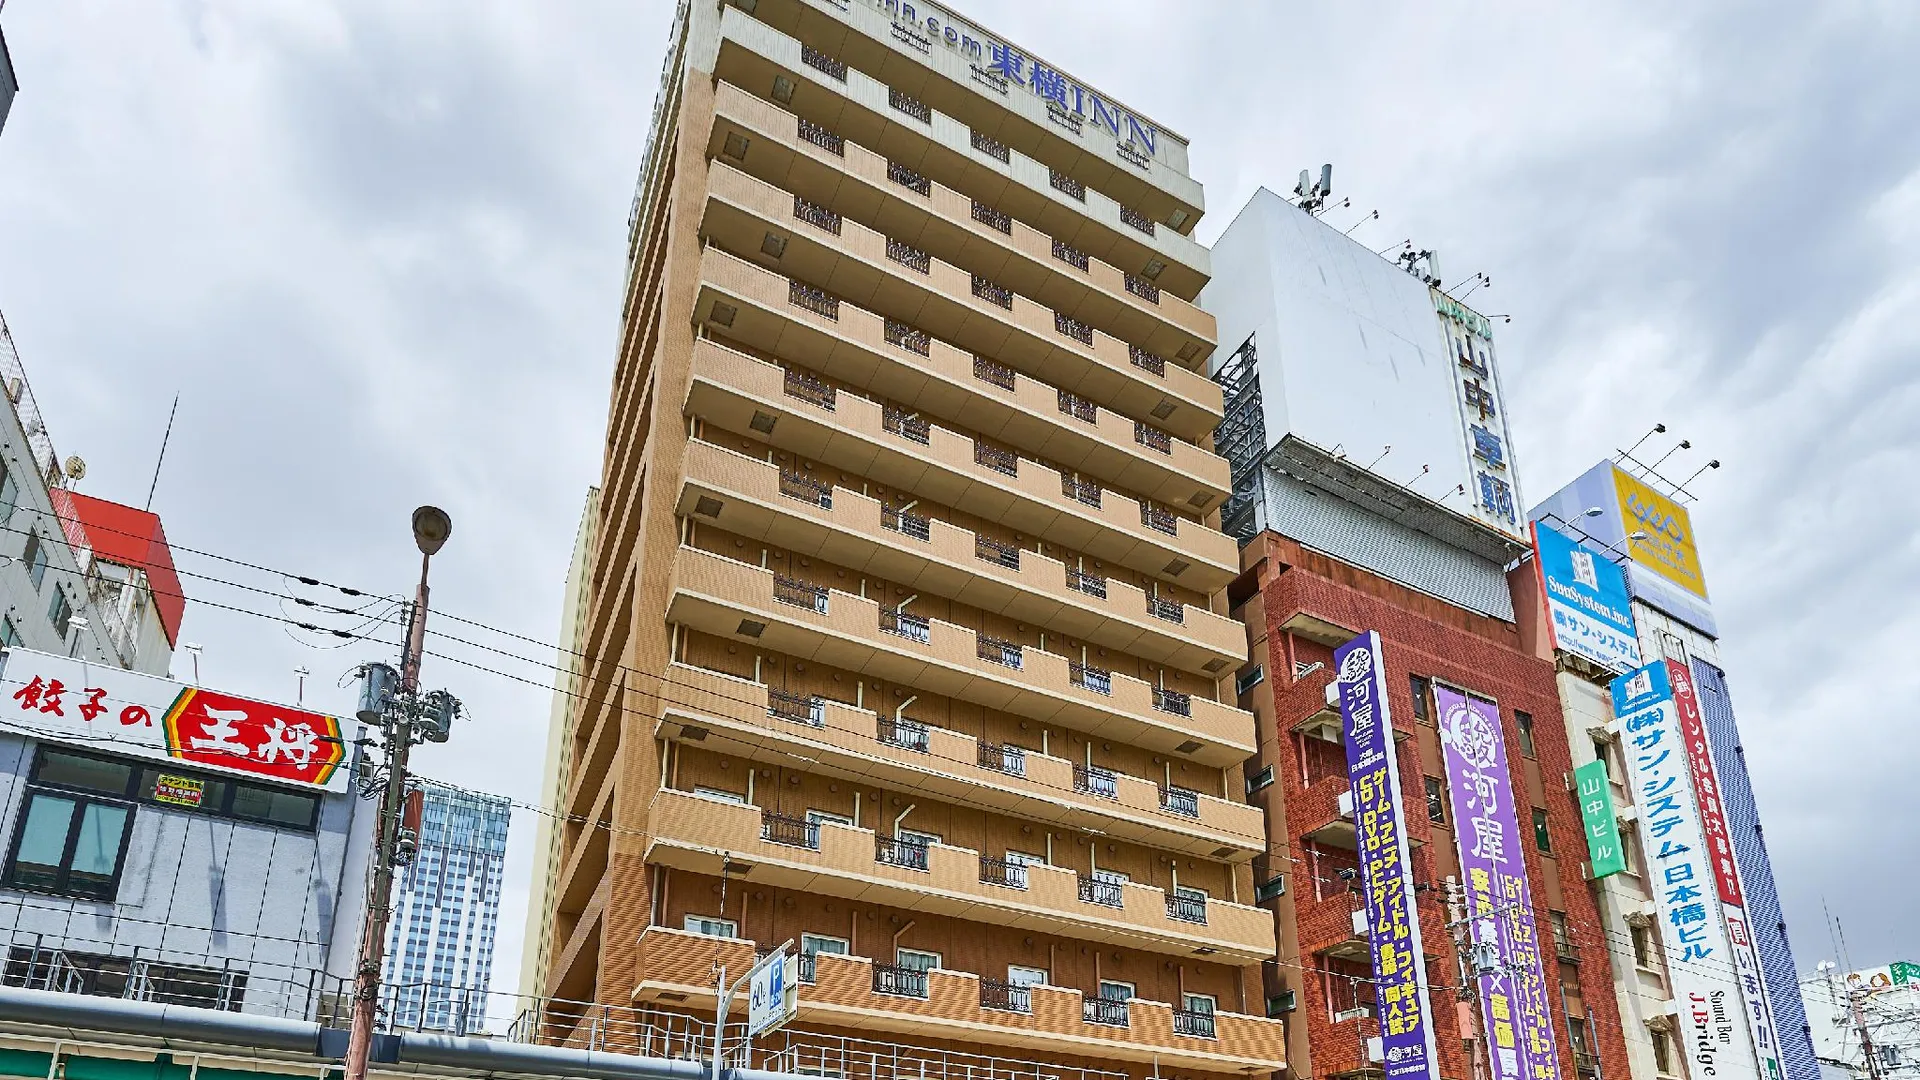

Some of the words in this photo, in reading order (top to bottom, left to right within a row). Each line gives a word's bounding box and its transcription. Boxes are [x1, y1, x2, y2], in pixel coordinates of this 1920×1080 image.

[985, 40, 1158, 155] 東横INN
[13, 674, 152, 727] 餃子の
[190, 703, 318, 770] 王将
[1341, 648, 1375, 737] 駿河屋
[1582, 777, 1612, 861] 山中ビル
[1709, 990, 1731, 1024] Sound
[1717, 1025, 1732, 1044] Bar
